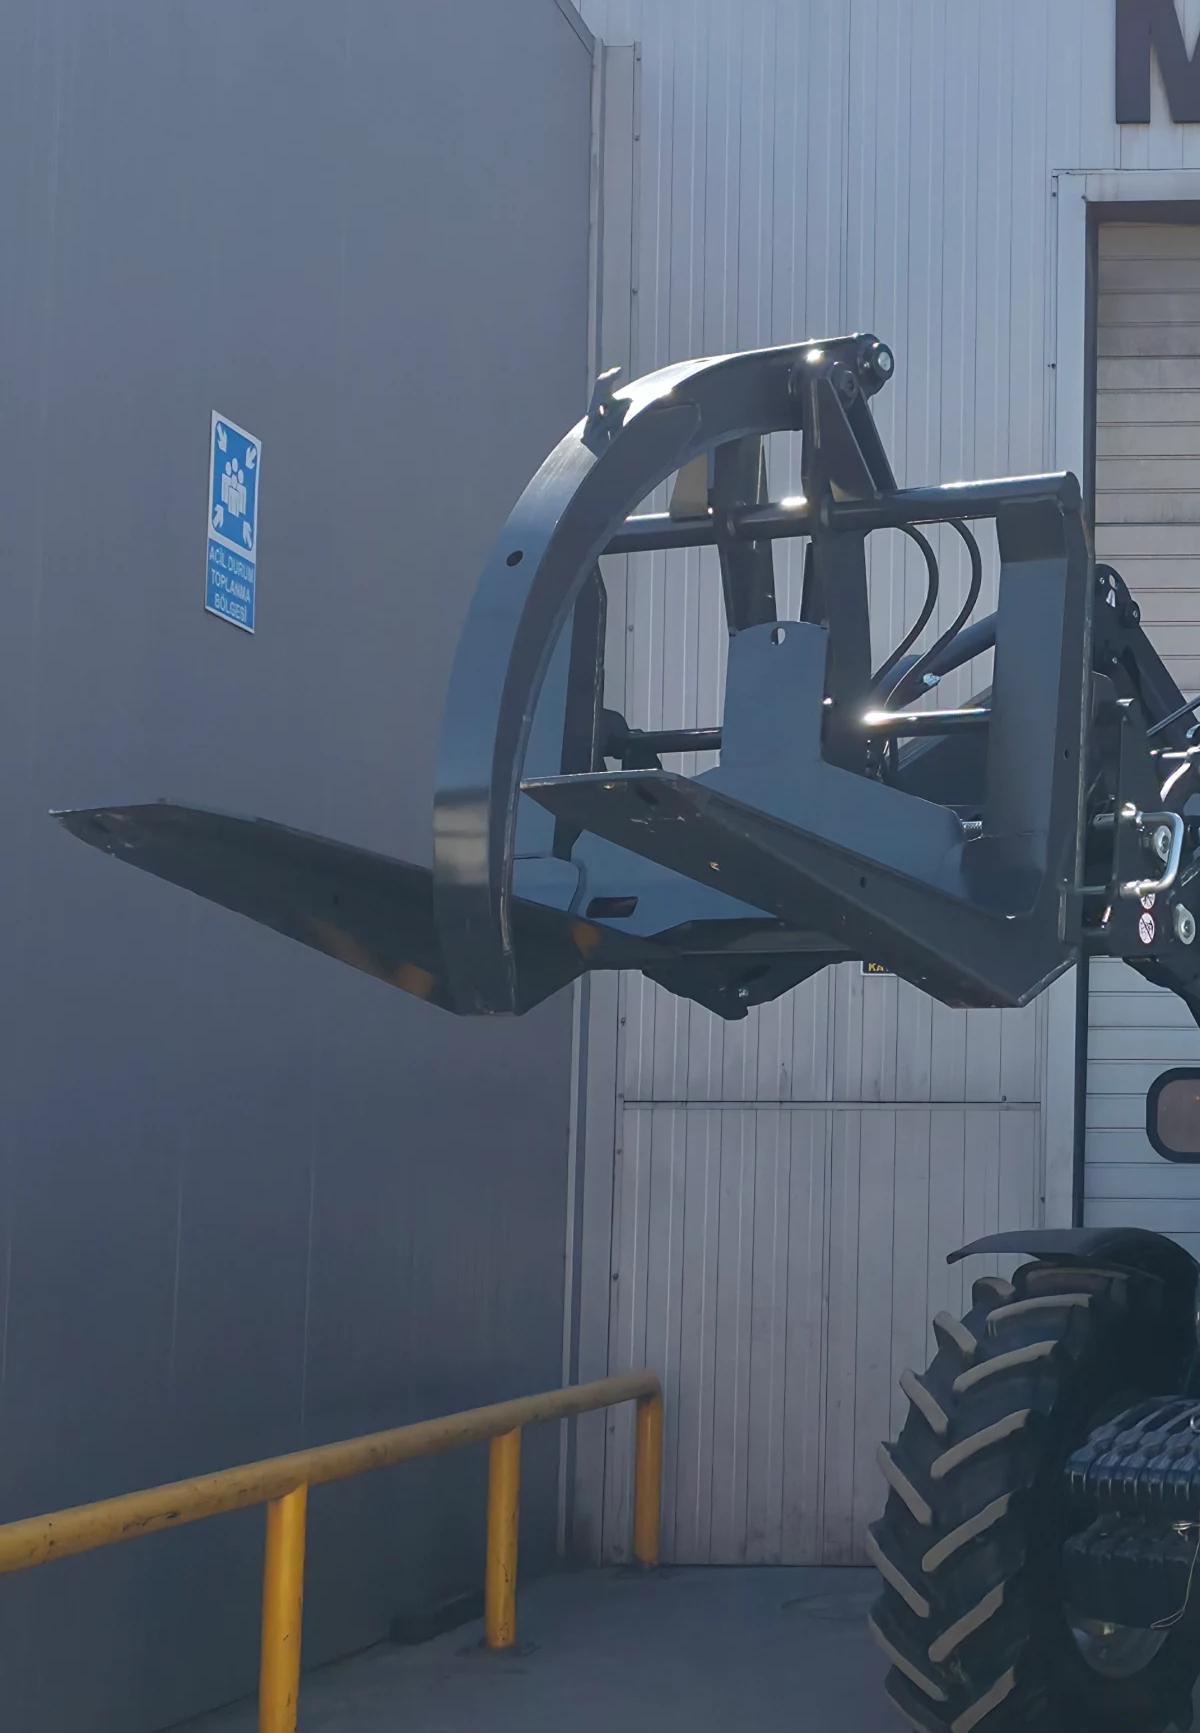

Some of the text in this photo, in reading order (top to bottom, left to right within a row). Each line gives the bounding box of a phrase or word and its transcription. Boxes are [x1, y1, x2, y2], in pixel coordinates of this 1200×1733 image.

[208, 546, 254, 583] ACİL DURUM
[211, 568, 251, 603] TOPLANMA
[214, 593, 247, 623] BÖLGESİ
